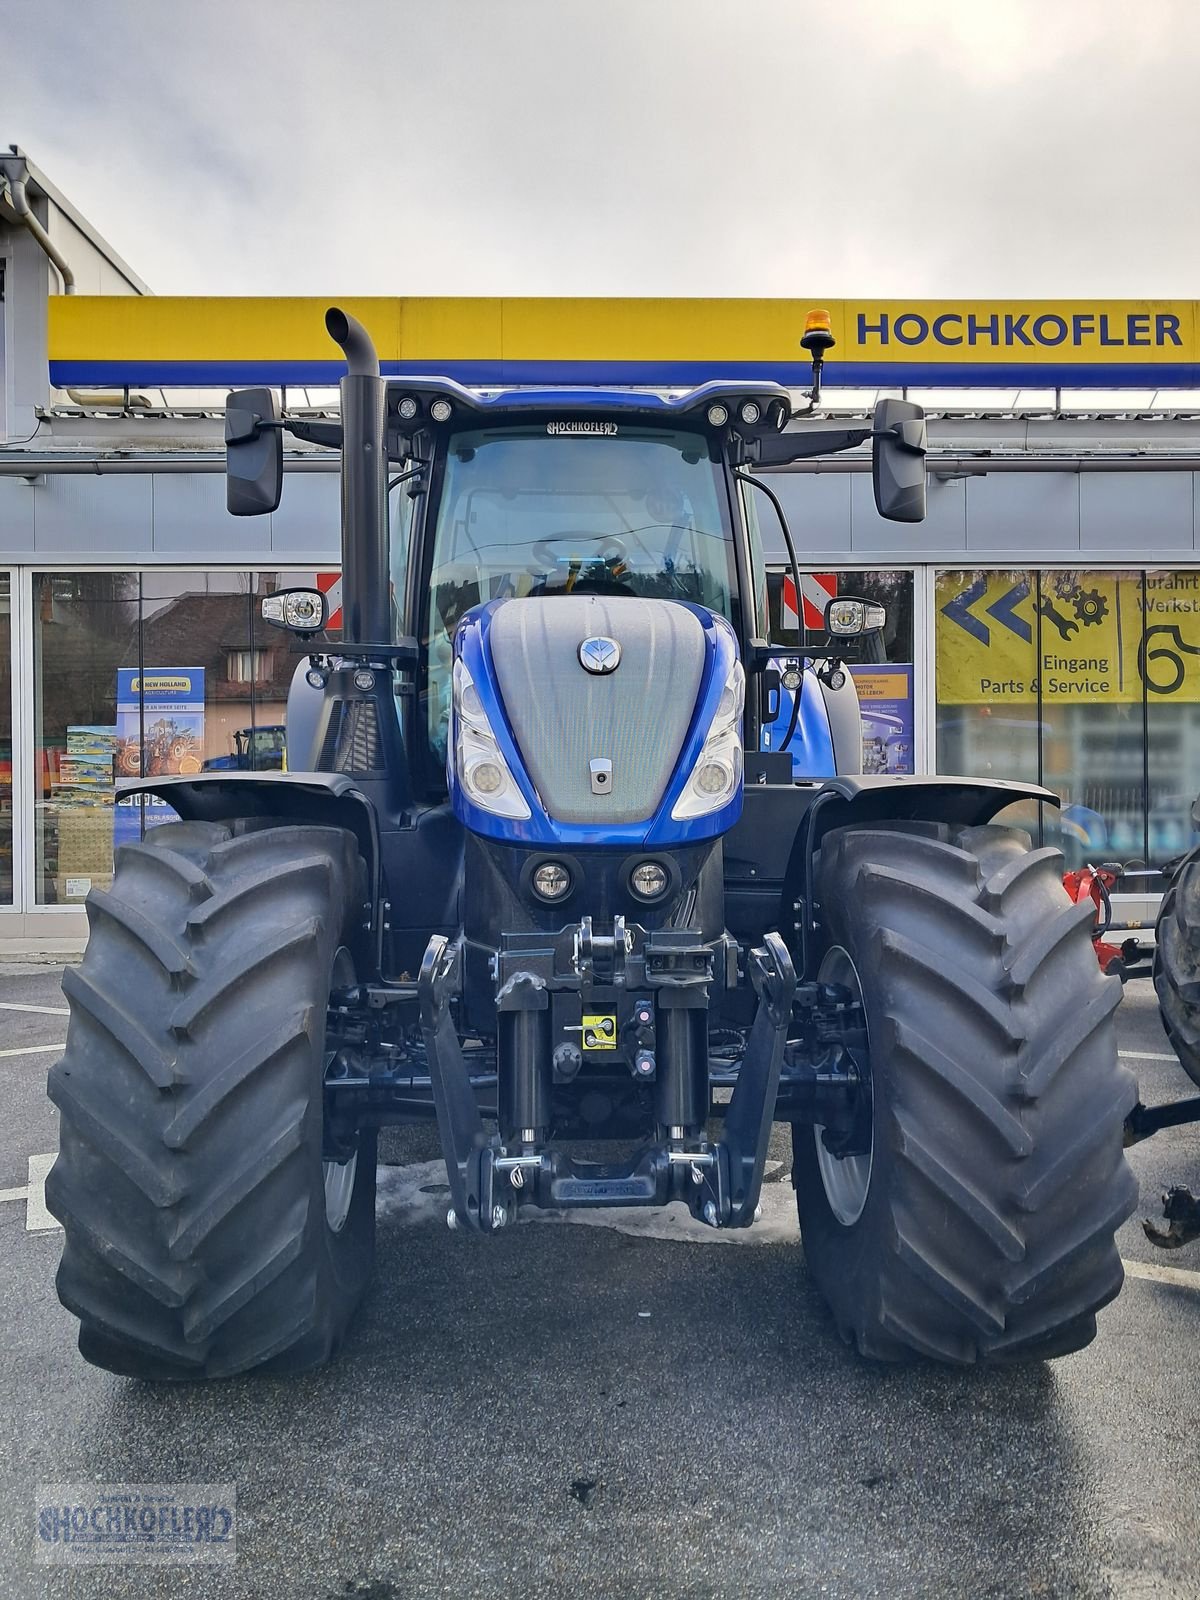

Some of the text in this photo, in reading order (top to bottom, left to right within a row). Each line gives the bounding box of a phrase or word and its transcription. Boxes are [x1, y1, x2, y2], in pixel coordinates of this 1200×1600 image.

[857, 313, 1183, 346] HOCHKOFLER
[549, 422, 612, 435] HOCHKOFLER
[1136, 597, 1200, 613] Werkst
[1043, 655, 1109, 673] Eingang
[980, 678, 1110, 694] Parts & Service
